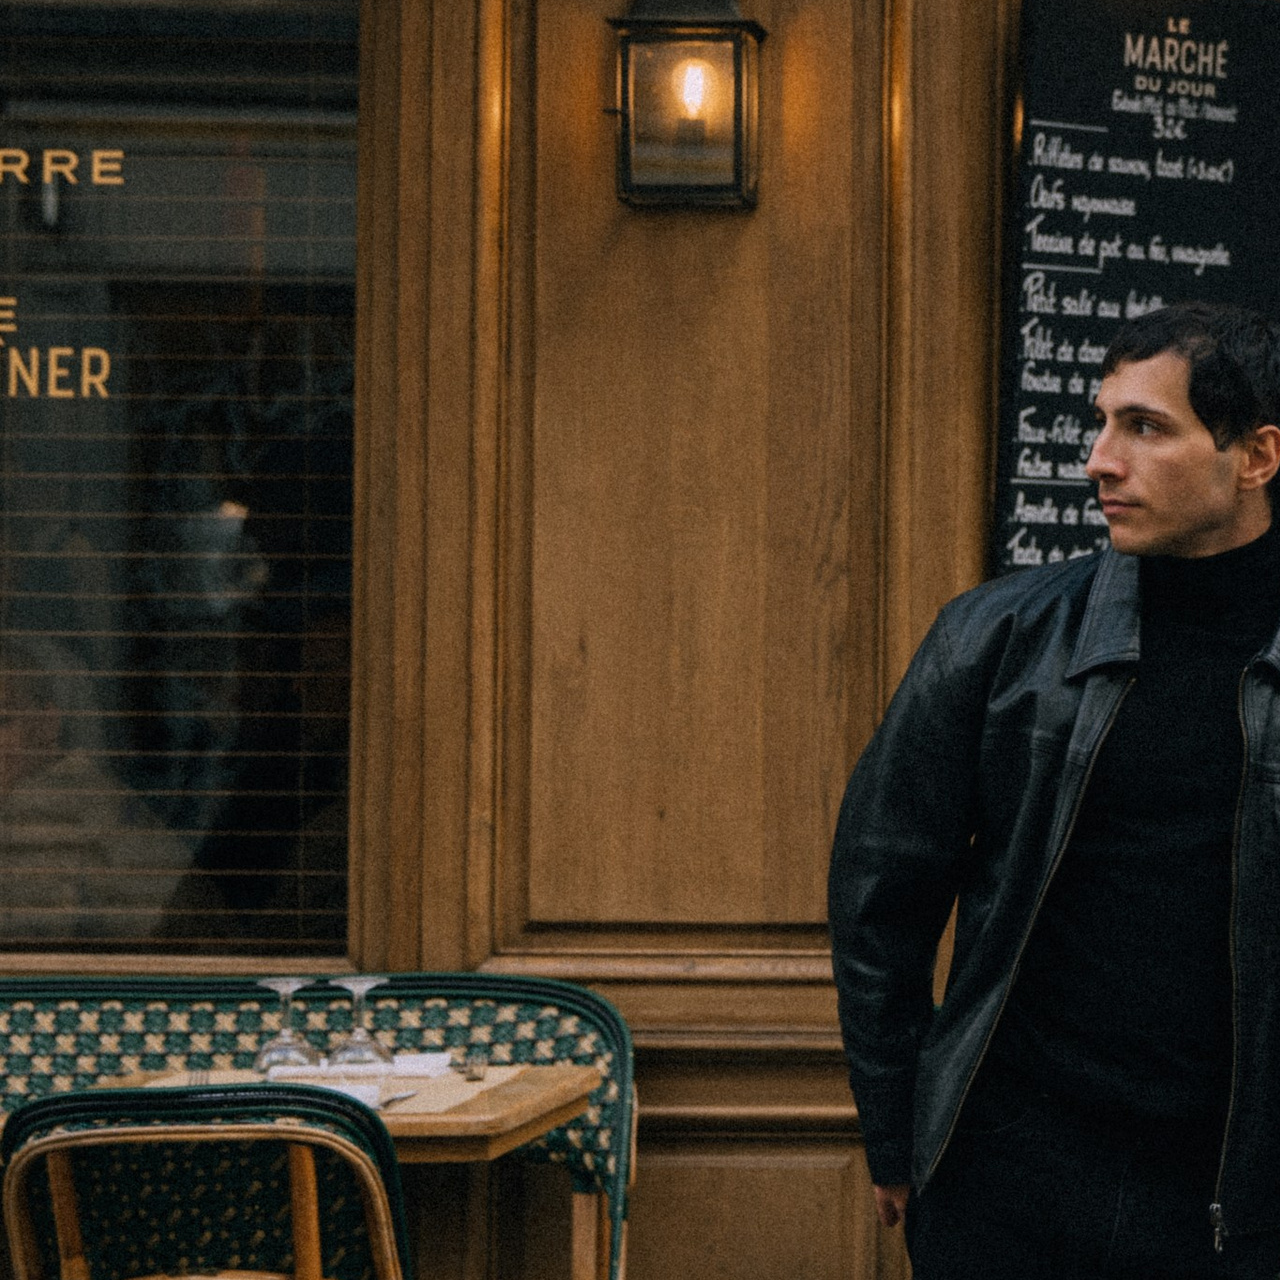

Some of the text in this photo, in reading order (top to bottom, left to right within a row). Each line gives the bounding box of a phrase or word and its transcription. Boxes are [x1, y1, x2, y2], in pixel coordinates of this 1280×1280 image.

[1168, 16, 1191, 35] LE
[1123, 32, 1229, 79] MARCHÉ
[1135, 75, 1216, 98] DU JOUR
